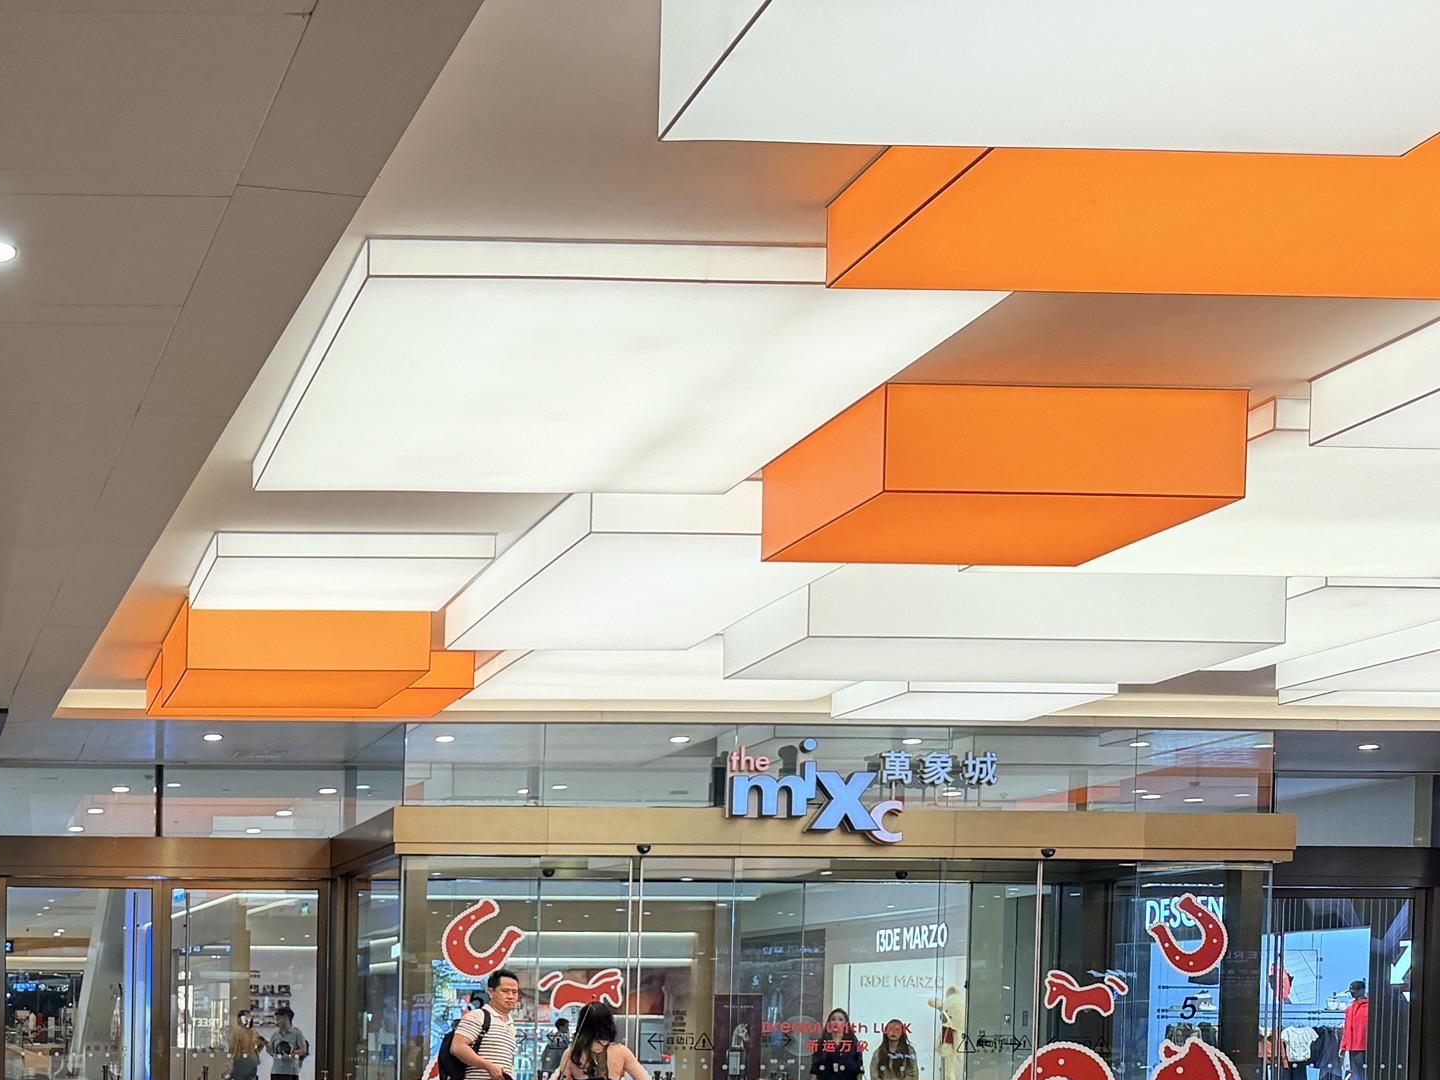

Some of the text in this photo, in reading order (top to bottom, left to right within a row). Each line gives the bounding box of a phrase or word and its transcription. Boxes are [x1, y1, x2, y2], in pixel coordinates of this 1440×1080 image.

[729, 746, 771, 773] the
[881, 750, 999, 786] 萬象城
[902, 922, 948, 950] MARZO
[1179, 996, 1198, 1020] 5
